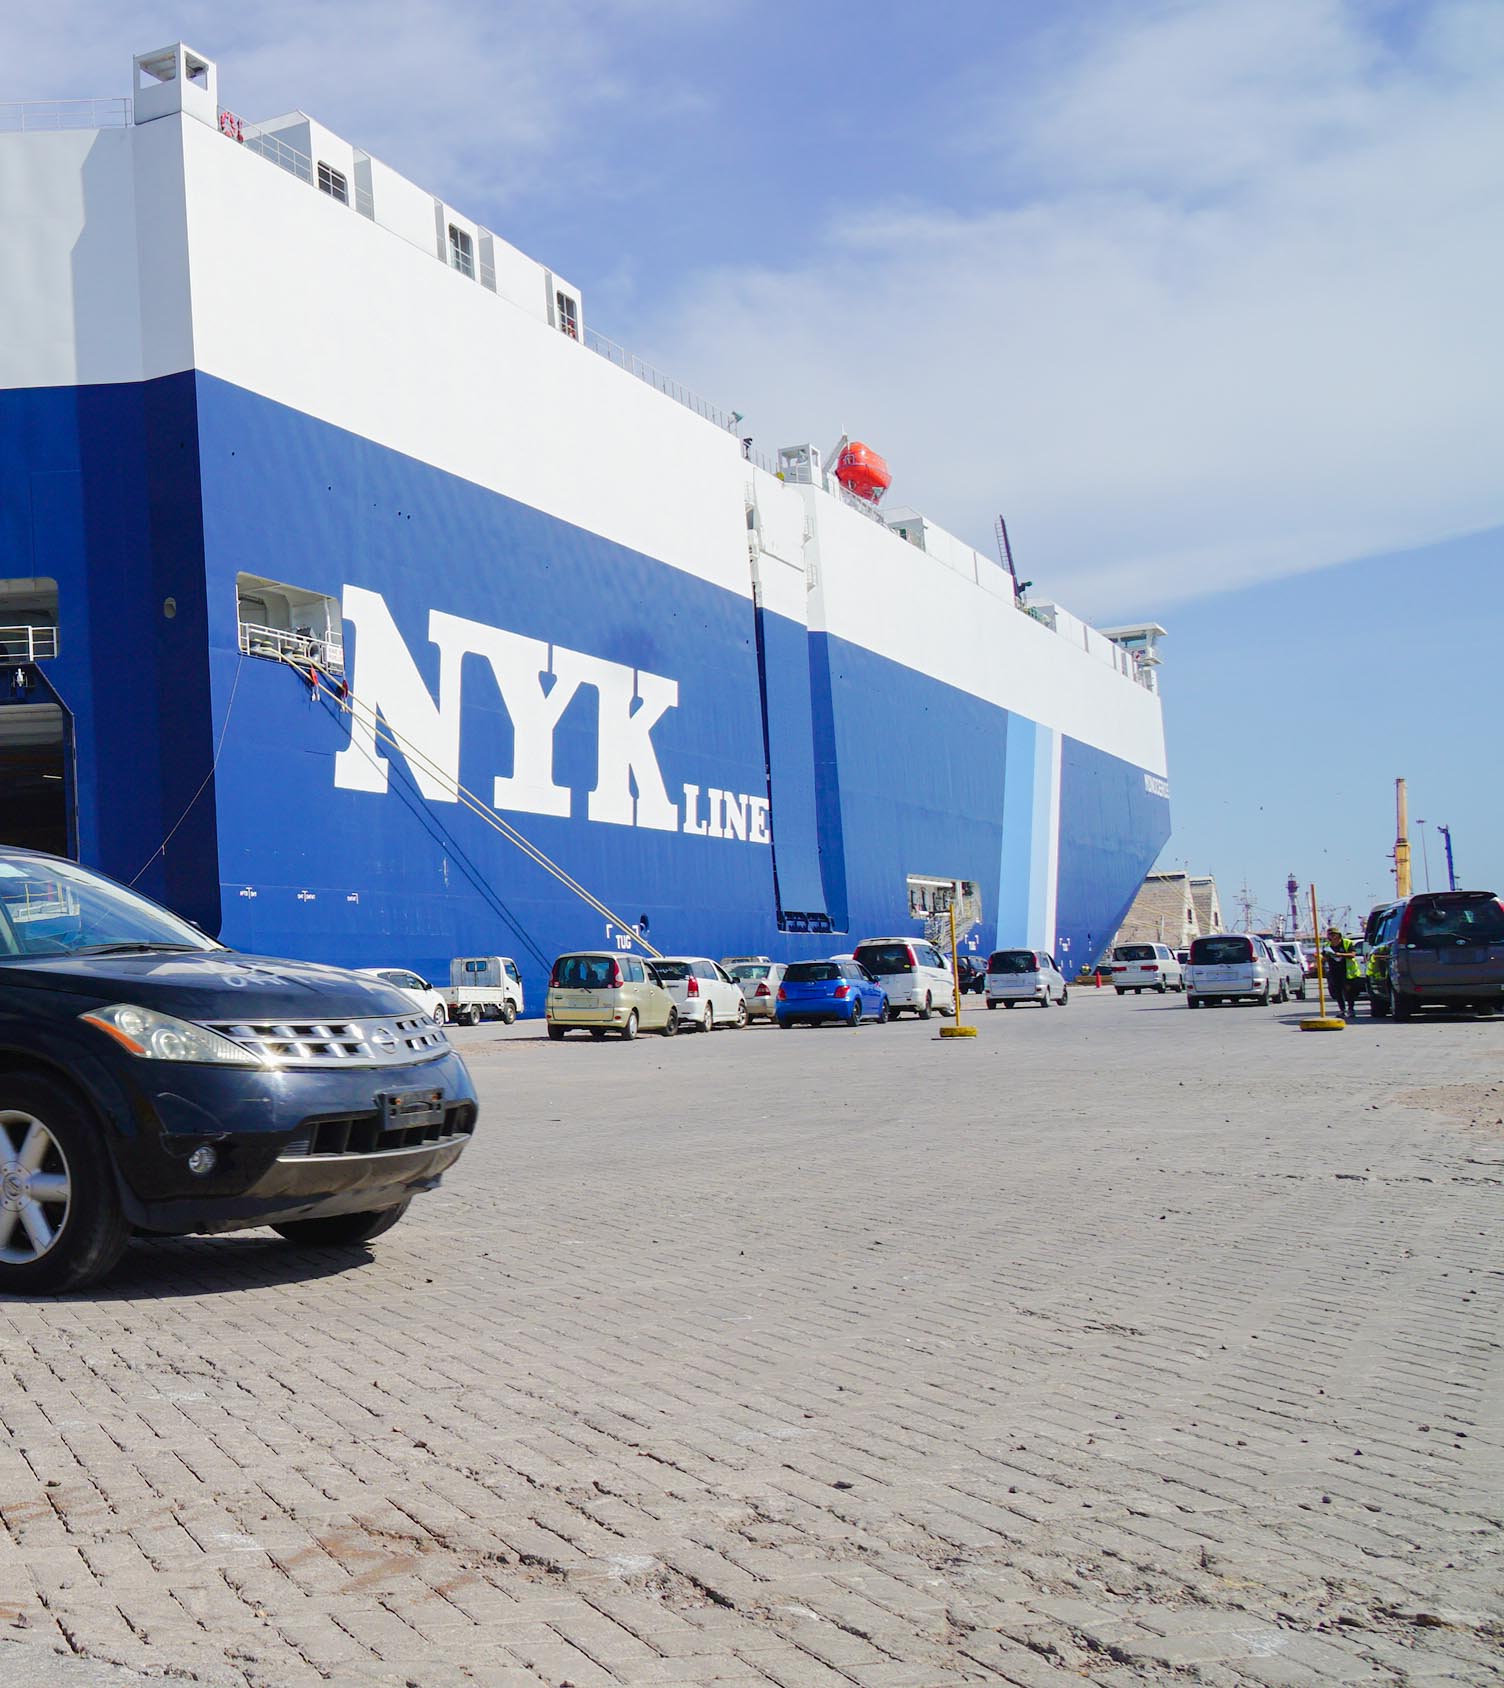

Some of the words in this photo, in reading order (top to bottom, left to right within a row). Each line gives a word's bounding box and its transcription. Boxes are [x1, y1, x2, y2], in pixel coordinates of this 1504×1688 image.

[334, 583, 679, 831] NYK
[682, 783, 770, 844] LINE
[615, 934, 632, 949] TUG
